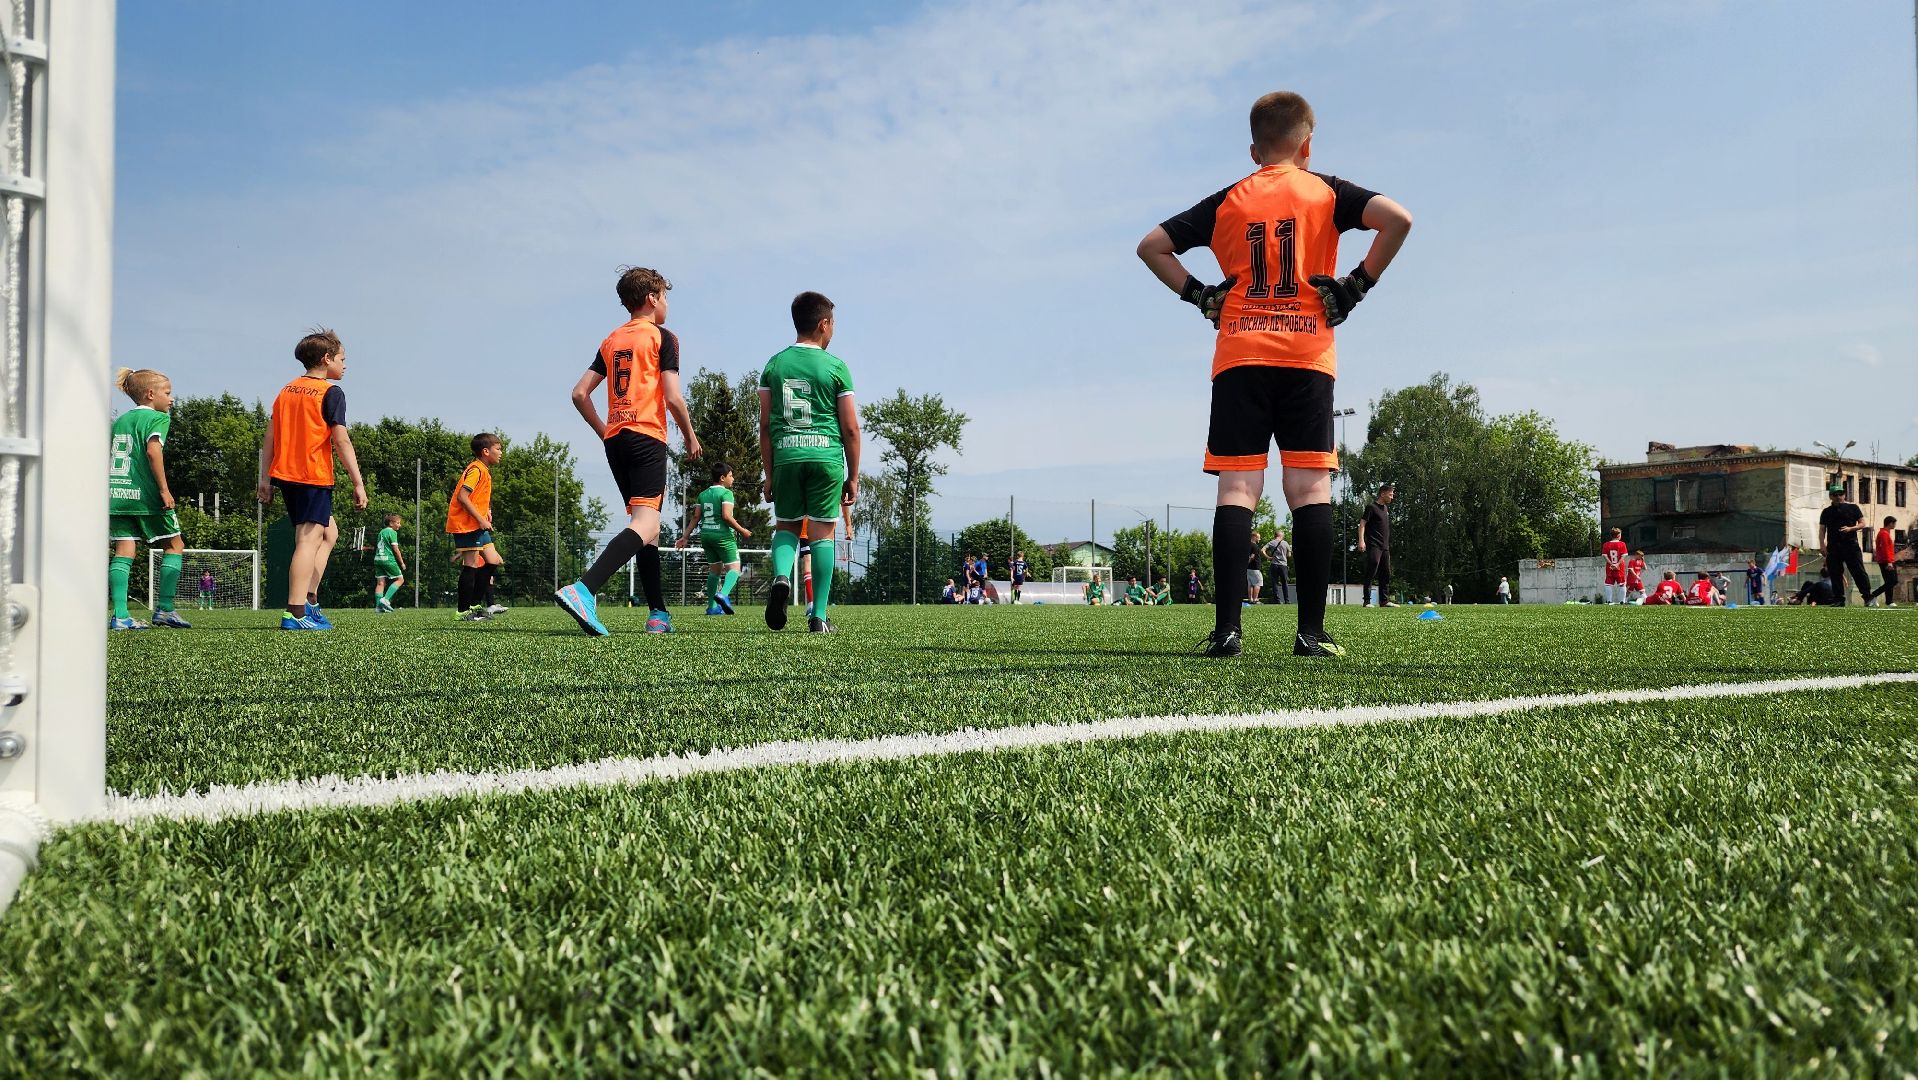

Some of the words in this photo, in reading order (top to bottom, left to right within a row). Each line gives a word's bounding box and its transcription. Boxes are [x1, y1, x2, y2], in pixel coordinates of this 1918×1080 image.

[1245, 218, 1298, 298] 11
[613, 349, 633, 399] 6
[783, 379, 812, 427] 6
[111, 434, 133, 476] 8
[703, 503, 715, 521] 2
[1017, 565, 1024, 575] 15
[1610, 550, 1618, 564] 8
[1691, 584, 1700, 597] 4
